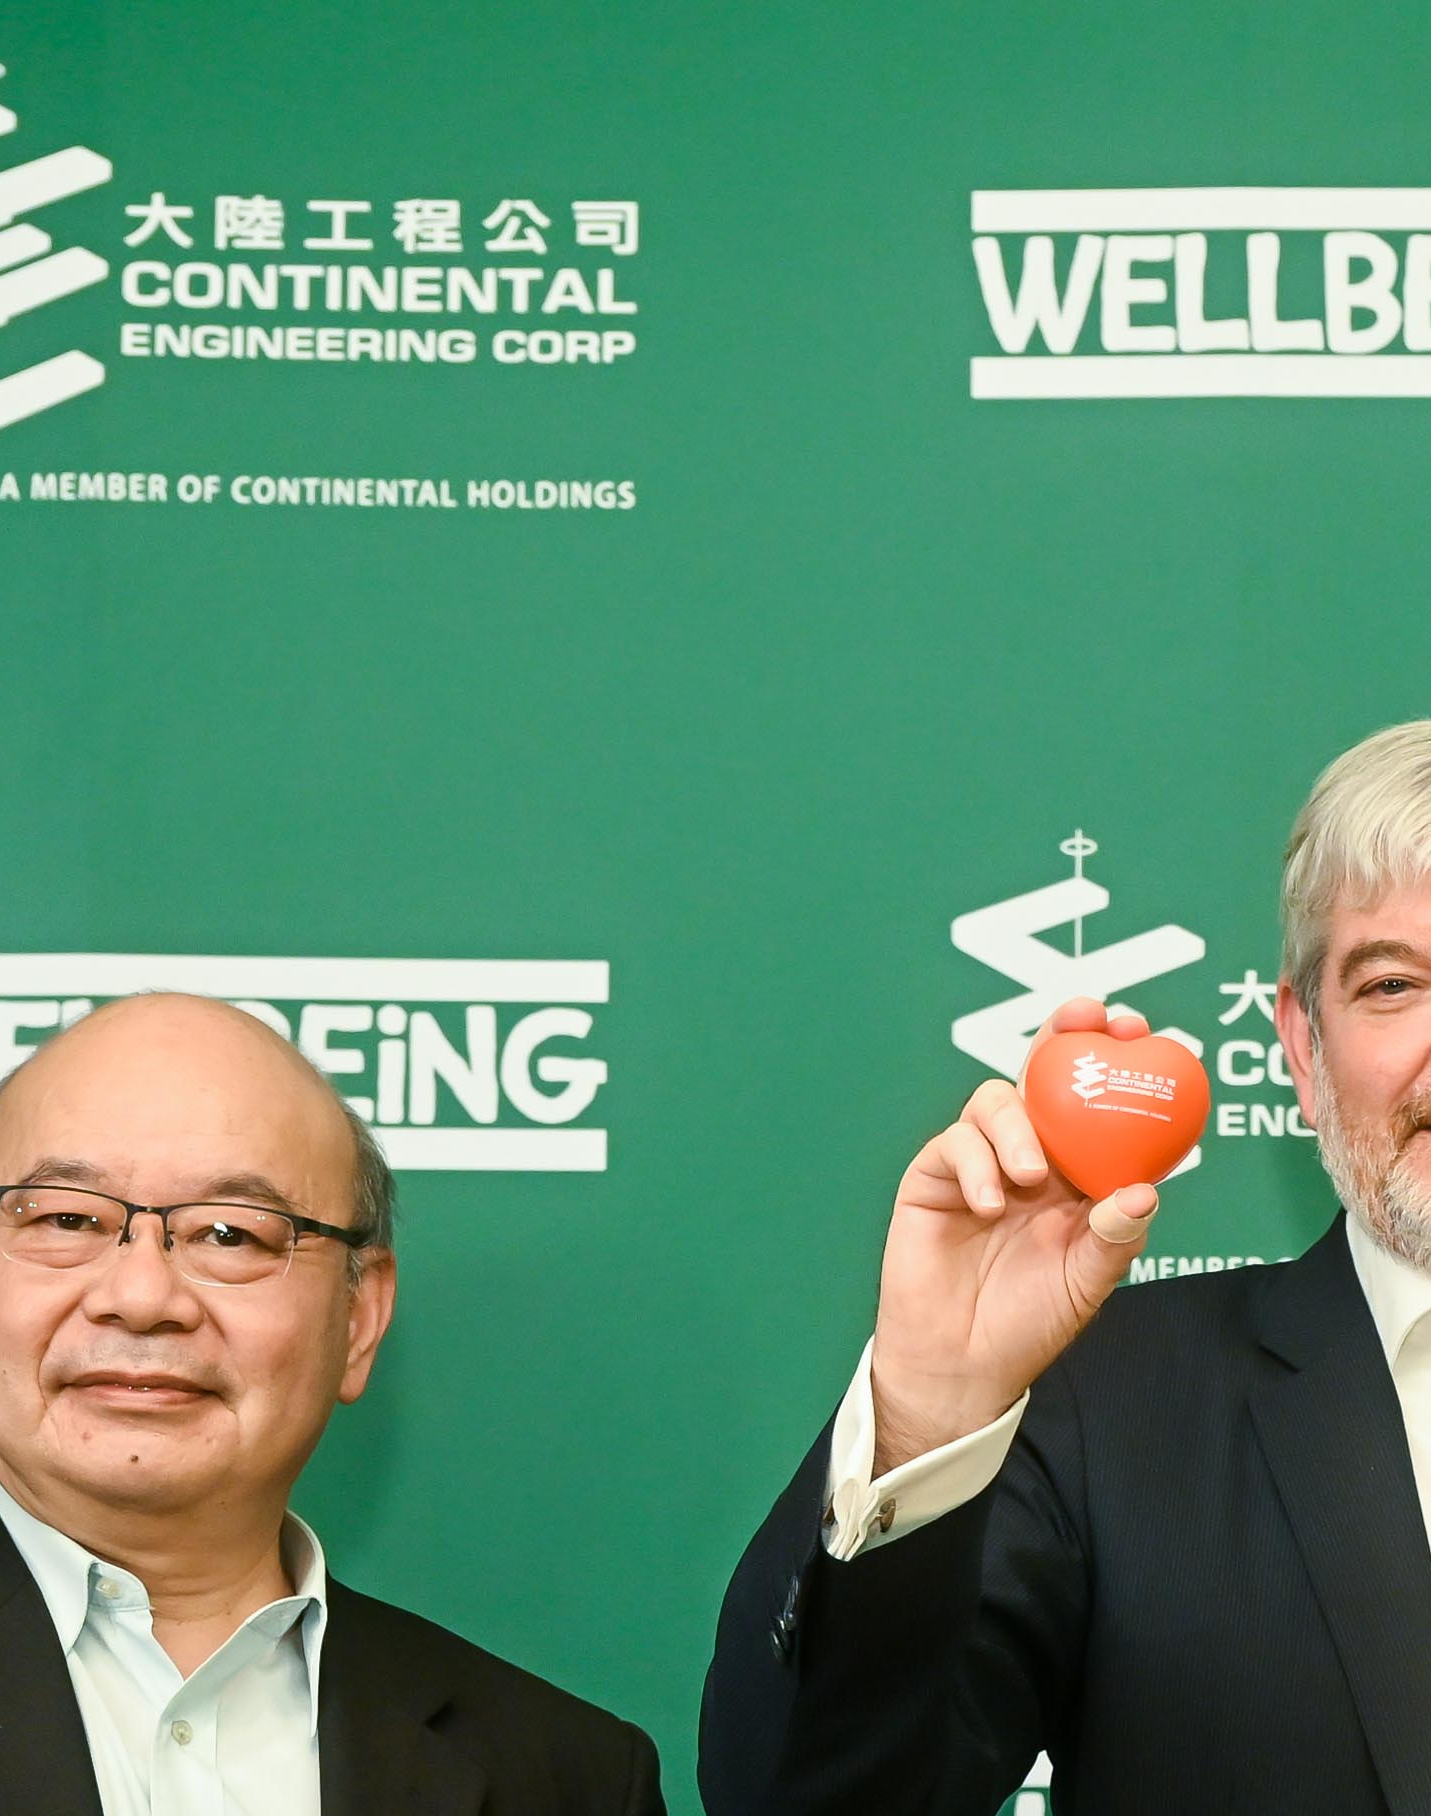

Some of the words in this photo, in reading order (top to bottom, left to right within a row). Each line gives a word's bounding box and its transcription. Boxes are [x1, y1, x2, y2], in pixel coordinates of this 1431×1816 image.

[124, 192, 639, 256] 大陸工程公司
[121, 260, 638, 315] CONTINENTAL
[120, 323, 477, 363] ENGINEERING
[492, 329, 636, 364] CORP
[30, 472, 168, 502] MEMBER
[177, 474, 221, 503] OF
[230, 475, 458, 508] CONTINENTAL
[467, 479, 636, 510] HOLDINGS
